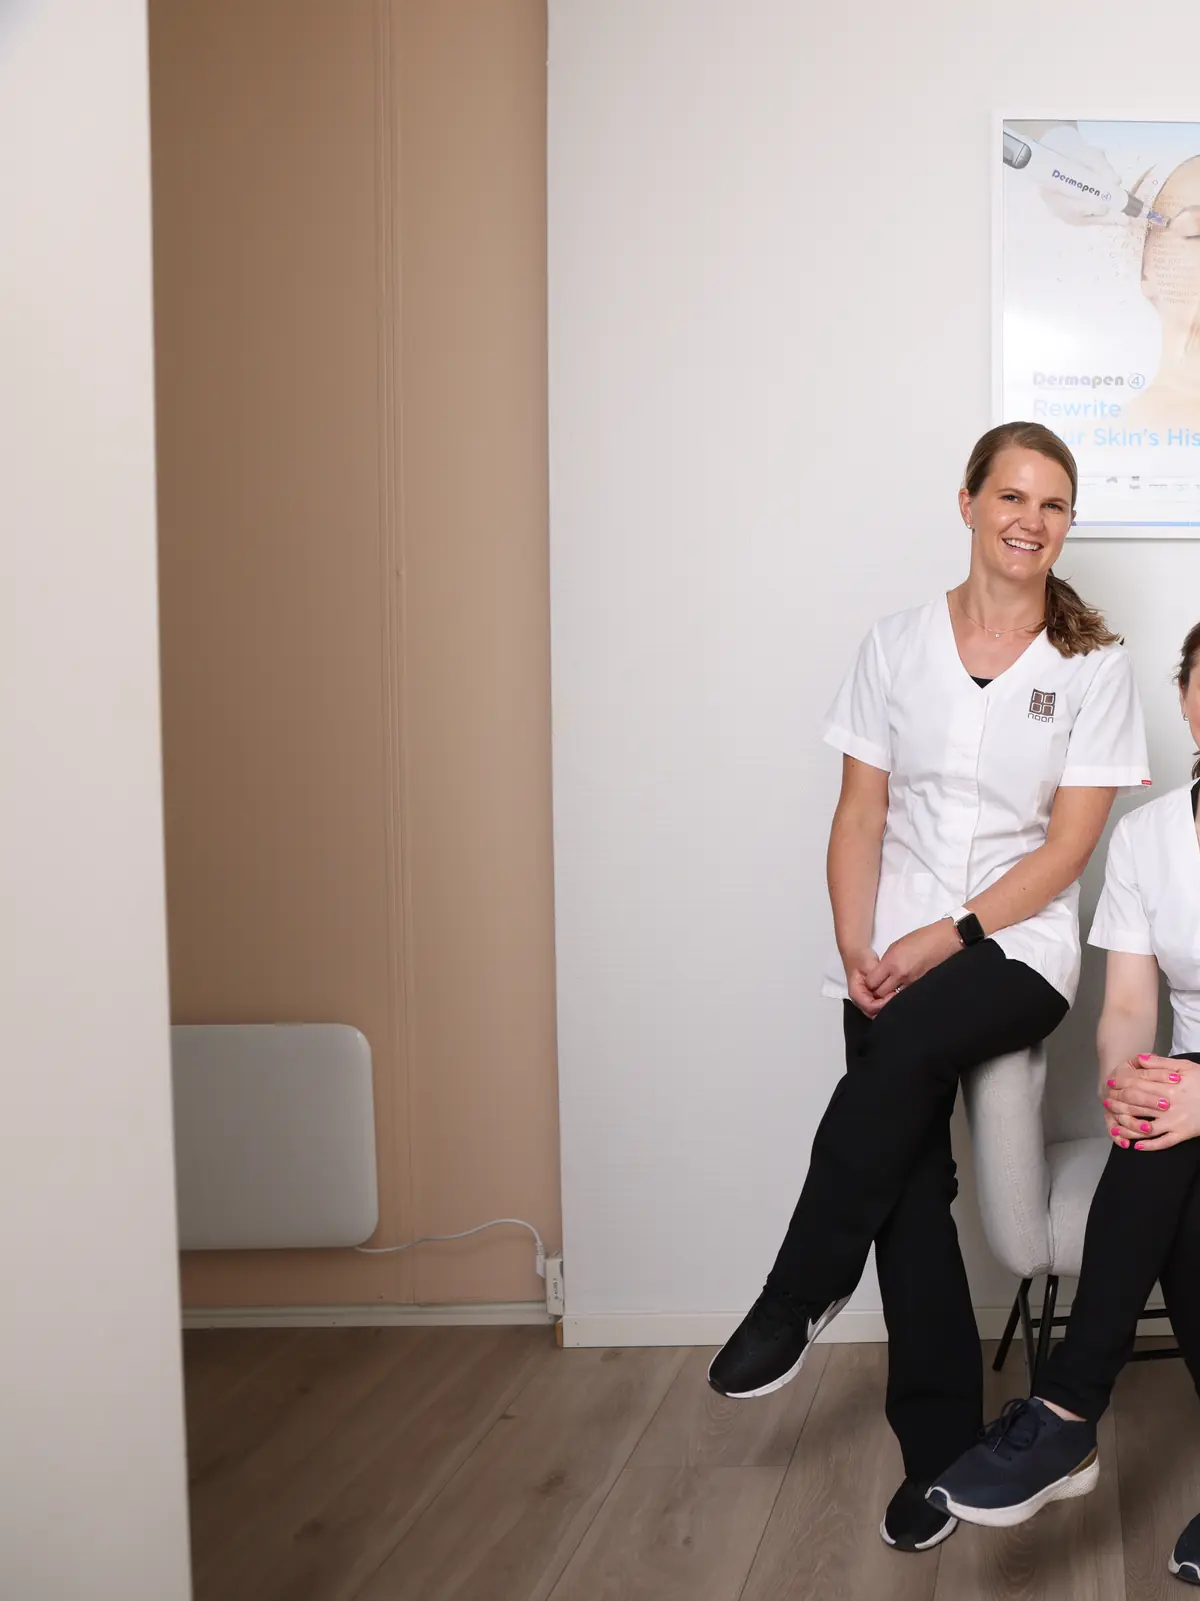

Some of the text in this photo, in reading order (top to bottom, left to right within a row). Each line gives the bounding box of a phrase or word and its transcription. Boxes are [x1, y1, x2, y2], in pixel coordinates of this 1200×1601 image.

[1052, 169, 1101, 197] Dermapen
[1032, 371, 1124, 389] Dermapen
[1033, 399, 1122, 419] Rewrite
[1028, 712, 1054, 723] noon
